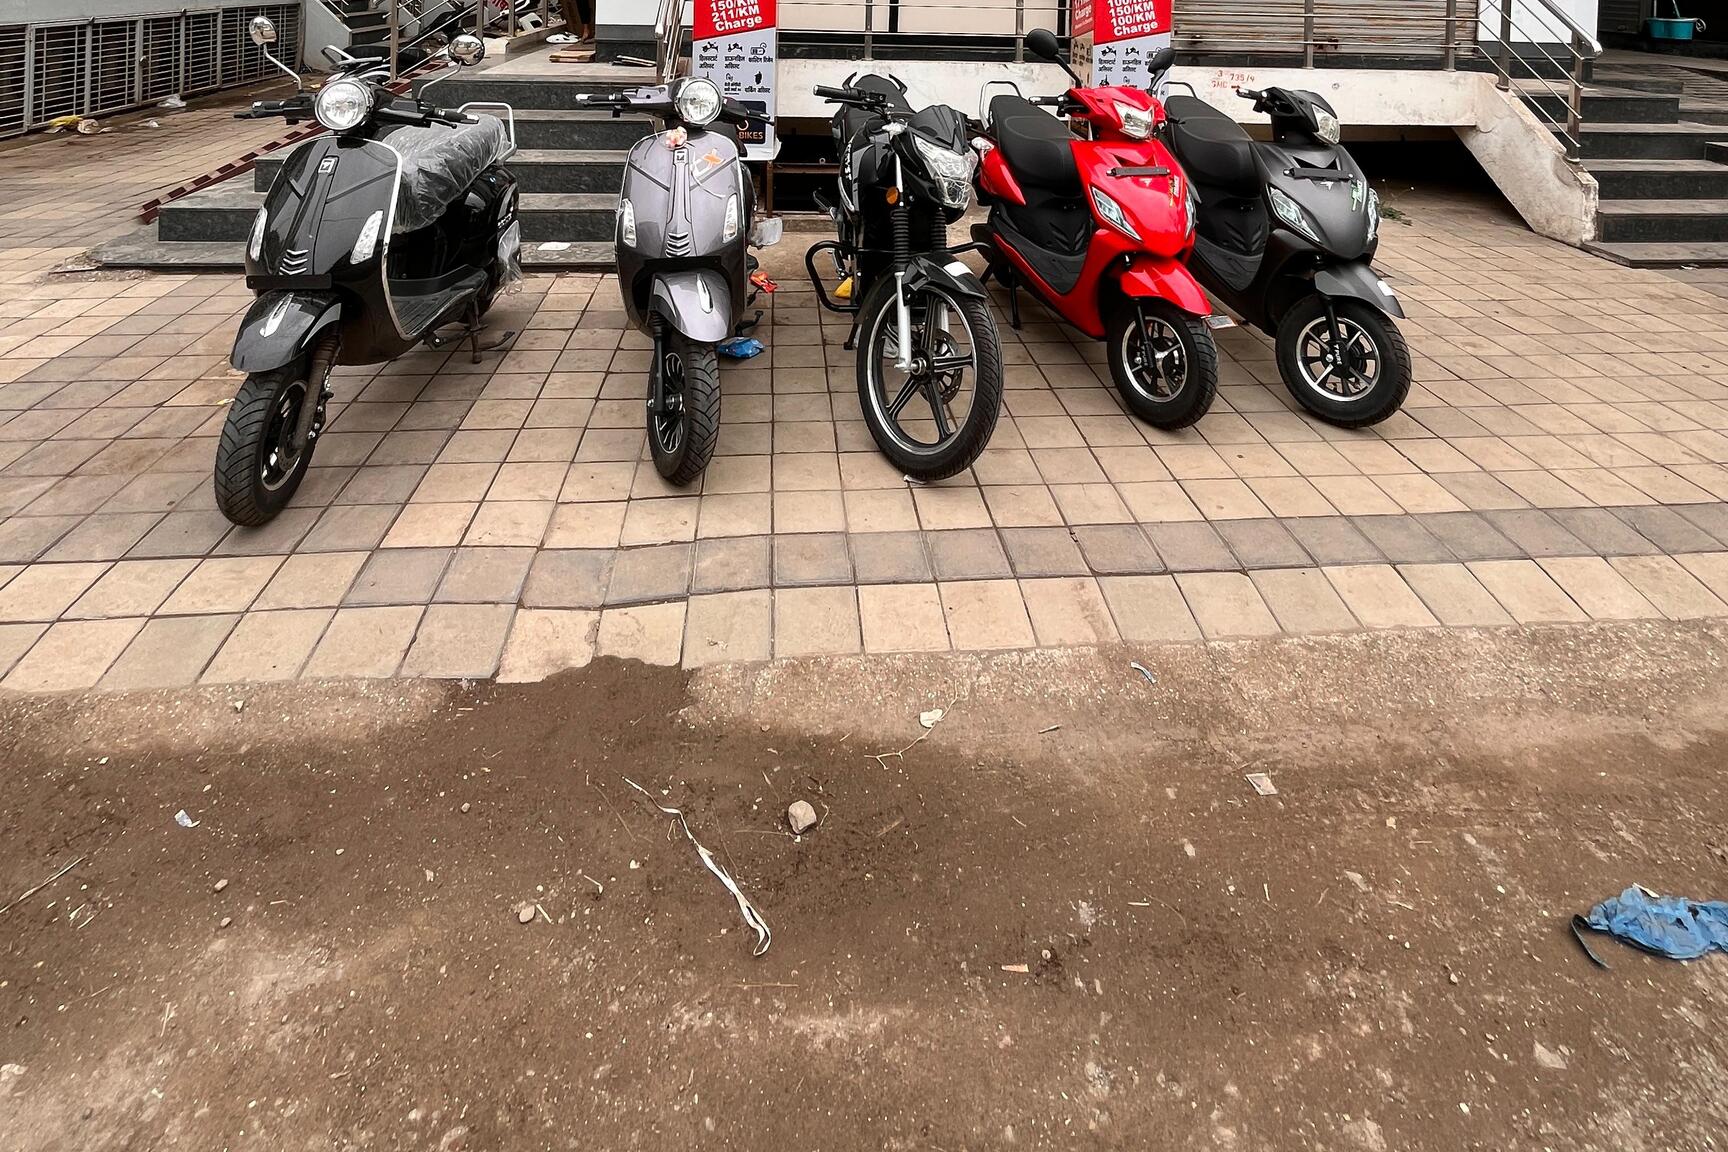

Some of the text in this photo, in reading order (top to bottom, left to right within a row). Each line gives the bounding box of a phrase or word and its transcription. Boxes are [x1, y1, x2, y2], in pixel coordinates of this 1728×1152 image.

[711, 5, 760, 22] 211/KM
[1108, 1, 1154, 17] 150/KM
[715, 15, 763, 31] Charge
[1110, 10, 1156, 27] 100/KM
[1113, 21, 1159, 36] Charge
